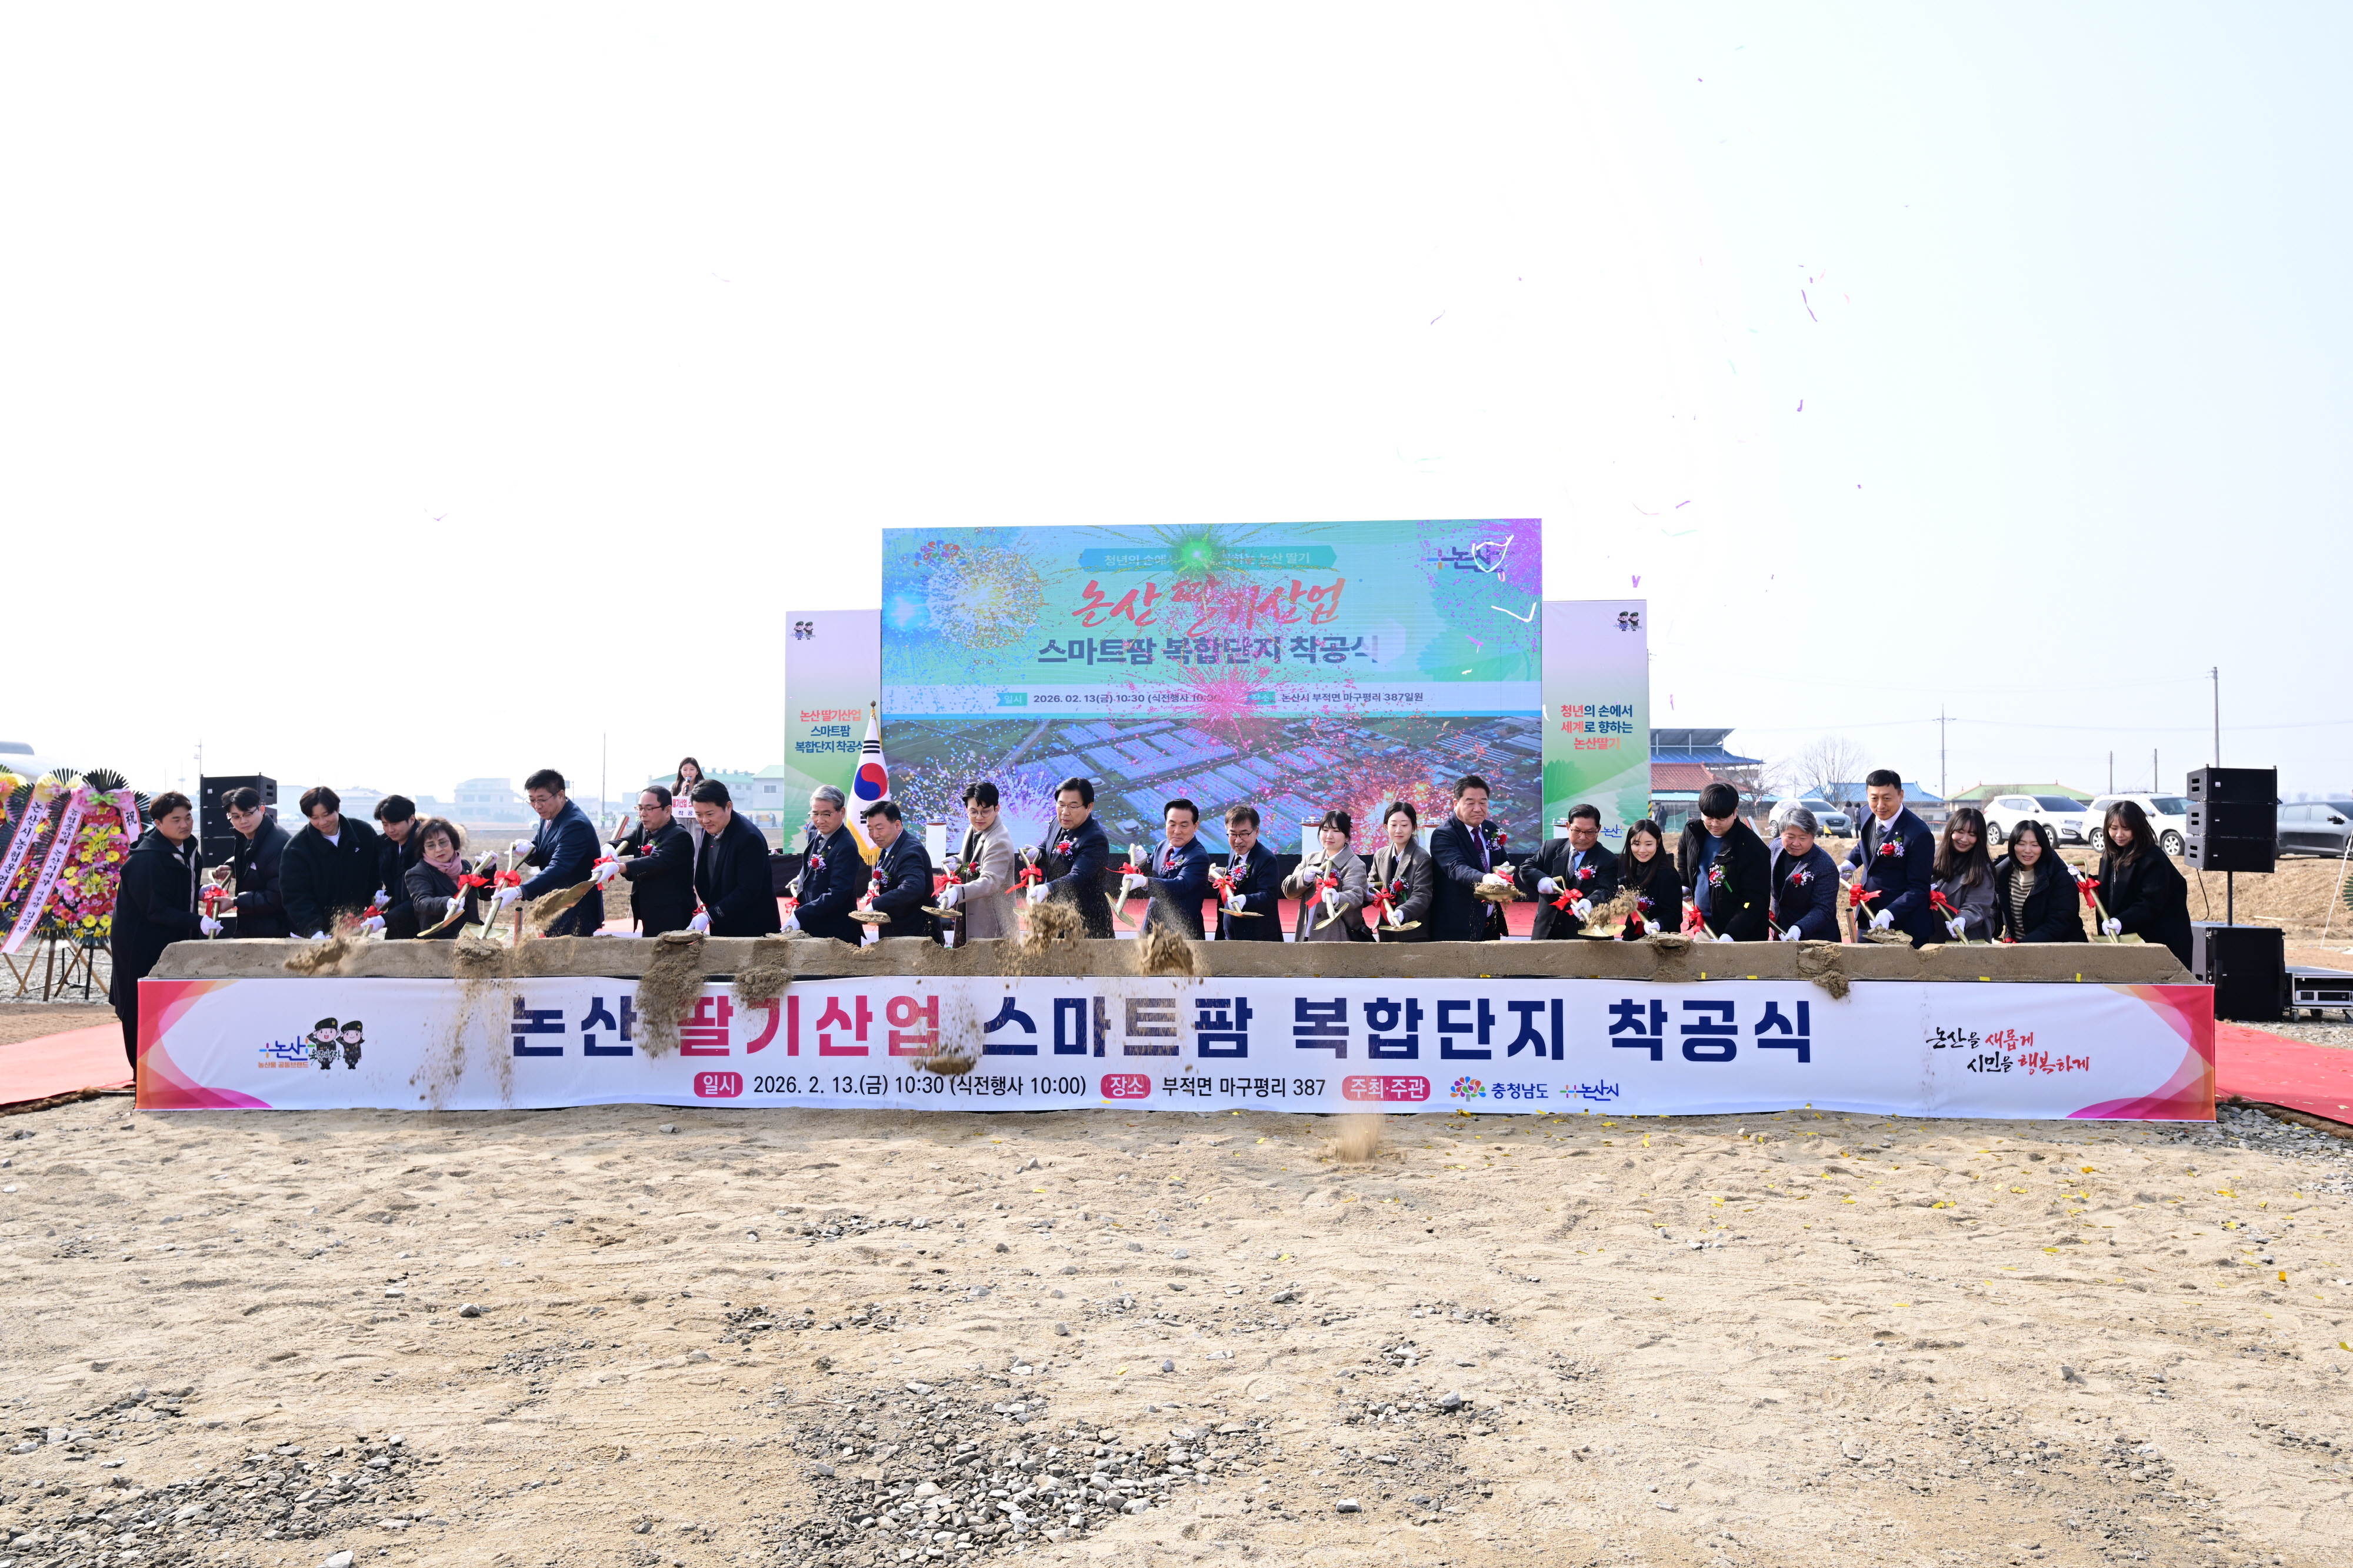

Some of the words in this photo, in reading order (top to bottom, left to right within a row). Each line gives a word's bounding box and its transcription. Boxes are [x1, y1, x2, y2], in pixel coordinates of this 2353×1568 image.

[1104, 555, 1139, 566] 청년의
[1259, 553, 1283, 564] 논산
[1286, 552, 1309, 564] 딸기
[1072, 579, 1162, 628] 논산
[1038, 638, 1156, 666] 스마트팜
[1163, 636, 1281, 665] 복합단지
[1290, 635, 1378, 663] 착공식
[1004, 695, 1022, 704] 일시
[1034, 694, 1064, 704] 2026.
[1068, 694, 1082, 703] 02.
[1086, 693, 1112, 705] 13(금)
[1116, 693, 1144, 703] 10:30
[1148, 693, 1189, 705] (식전행사
[1281, 692, 1310, 703] 논산시
[1312, 692, 1341, 703] 부적면
[1343, 692, 1381, 703] 마구평리
[1384, 692, 1424, 702] 387일원
[800, 710, 820, 722] 논산
[821, 709, 861, 721] 딸기산업
[1561, 705, 1595, 717] 청년의
[1598, 705, 1632, 718] 손에서
[811, 725, 851, 737] 스마트팜
[1561, 721, 1595, 733] 세계로
[1598, 720, 1633, 733] 향하는
[795, 741, 834, 753] 복합단지
[1574, 737, 1620, 750] 논산딸기
[125, 811, 137, 826] 祝
[57, 809, 80, 846] 농협중앙회
[1600, 824, 1622, 838] 논산
[39, 849, 64, 886] 논산시지부
[511, 995, 636, 1056] 논산
[677, 995, 939, 1057] 딸기산업
[982, 996, 1252, 1057] 스마트팜
[1293, 996, 1564, 1060] 복합단지
[1609, 998, 1811, 1063] 착공식
[1926, 1027, 1980, 1049] 논산을
[1985, 1029, 2034, 1052] 새롭게
[268, 1036, 308, 1061] 논산
[309, 1049, 341, 1066] 육군병장
[1967, 1051, 2014, 1073] 시민을
[2017, 1051, 2089, 1075] 행복하게
[702, 1075, 735, 1095] 일시
[754, 1075, 802, 1093] 2026.
[809, 1075, 824, 1093] 2.
[833, 1074, 888, 1095] 13.(금)
[896, 1075, 942, 1093] 10:30
[949, 1075, 1024, 1096] (식전행사
[1032, 1075, 1086, 1096] 10:00)
[1109, 1076, 1144, 1095] 장소
[1162, 1076, 1212, 1096] 부적면
[1220, 1077, 1286, 1097] 마구평리
[1293, 1079, 1325, 1096] 387
[1350, 1078, 1425, 1099] 주최·주관
[1491, 1082, 1548, 1099] 충청남도
[1580, 1079, 1619, 1101] 논산시
